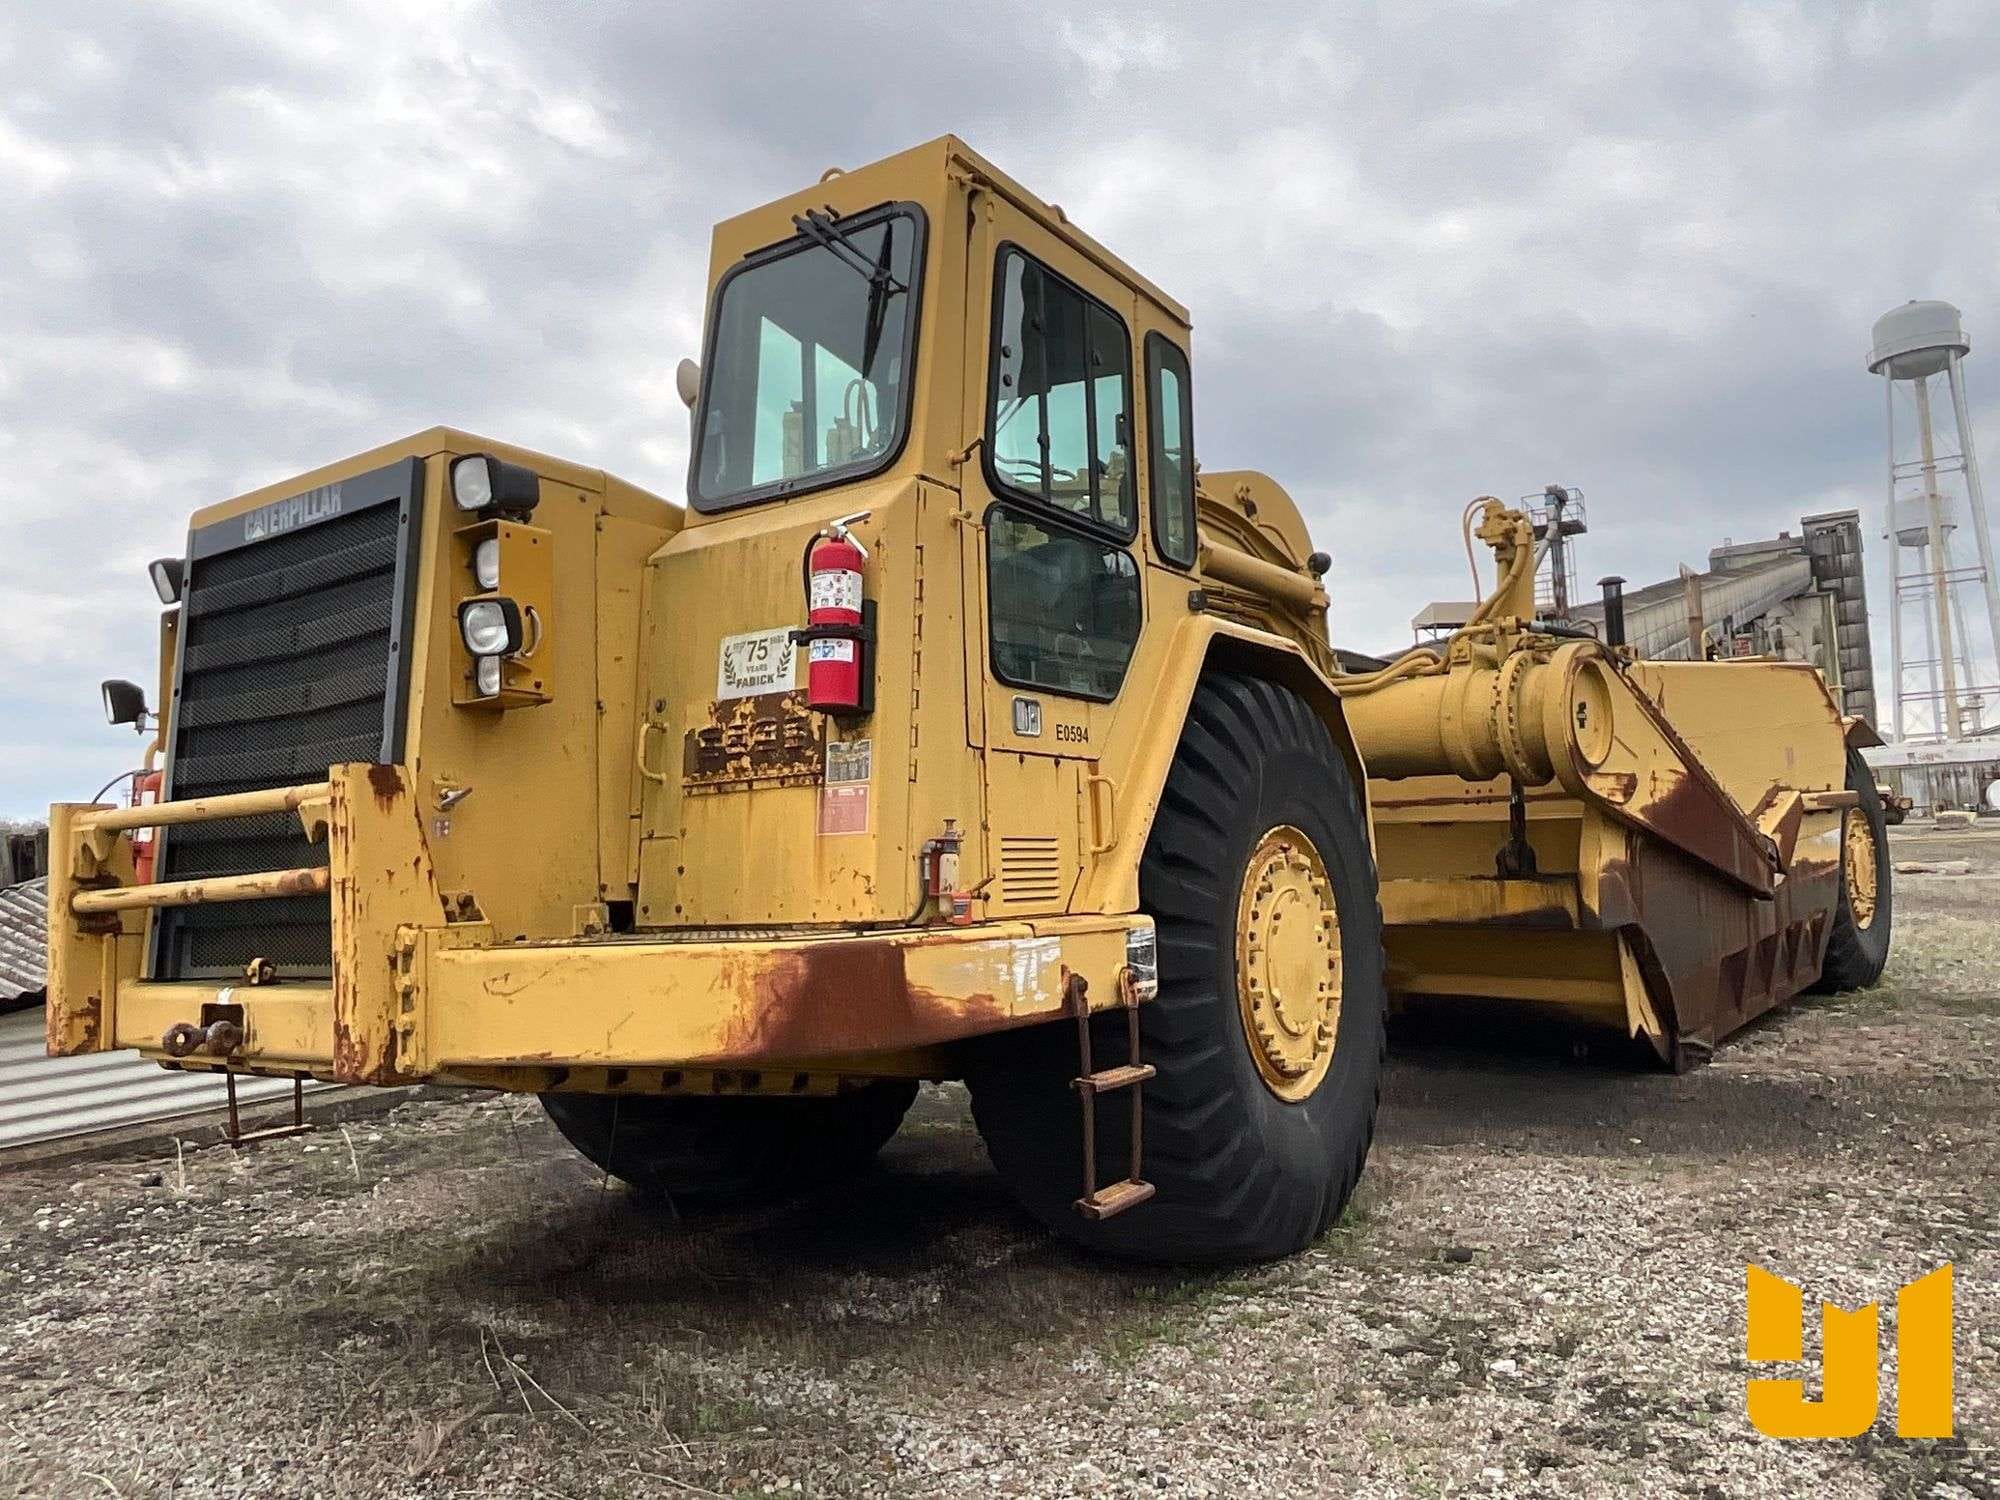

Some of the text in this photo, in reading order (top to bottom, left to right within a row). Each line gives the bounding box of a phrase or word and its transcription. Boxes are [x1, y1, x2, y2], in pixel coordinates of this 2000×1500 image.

[244, 484, 342, 541] CATERPILLAR
[747, 638, 768, 662] 75
[736, 673, 774, 688] FABICK
[1055, 723, 1089, 743] E0594
